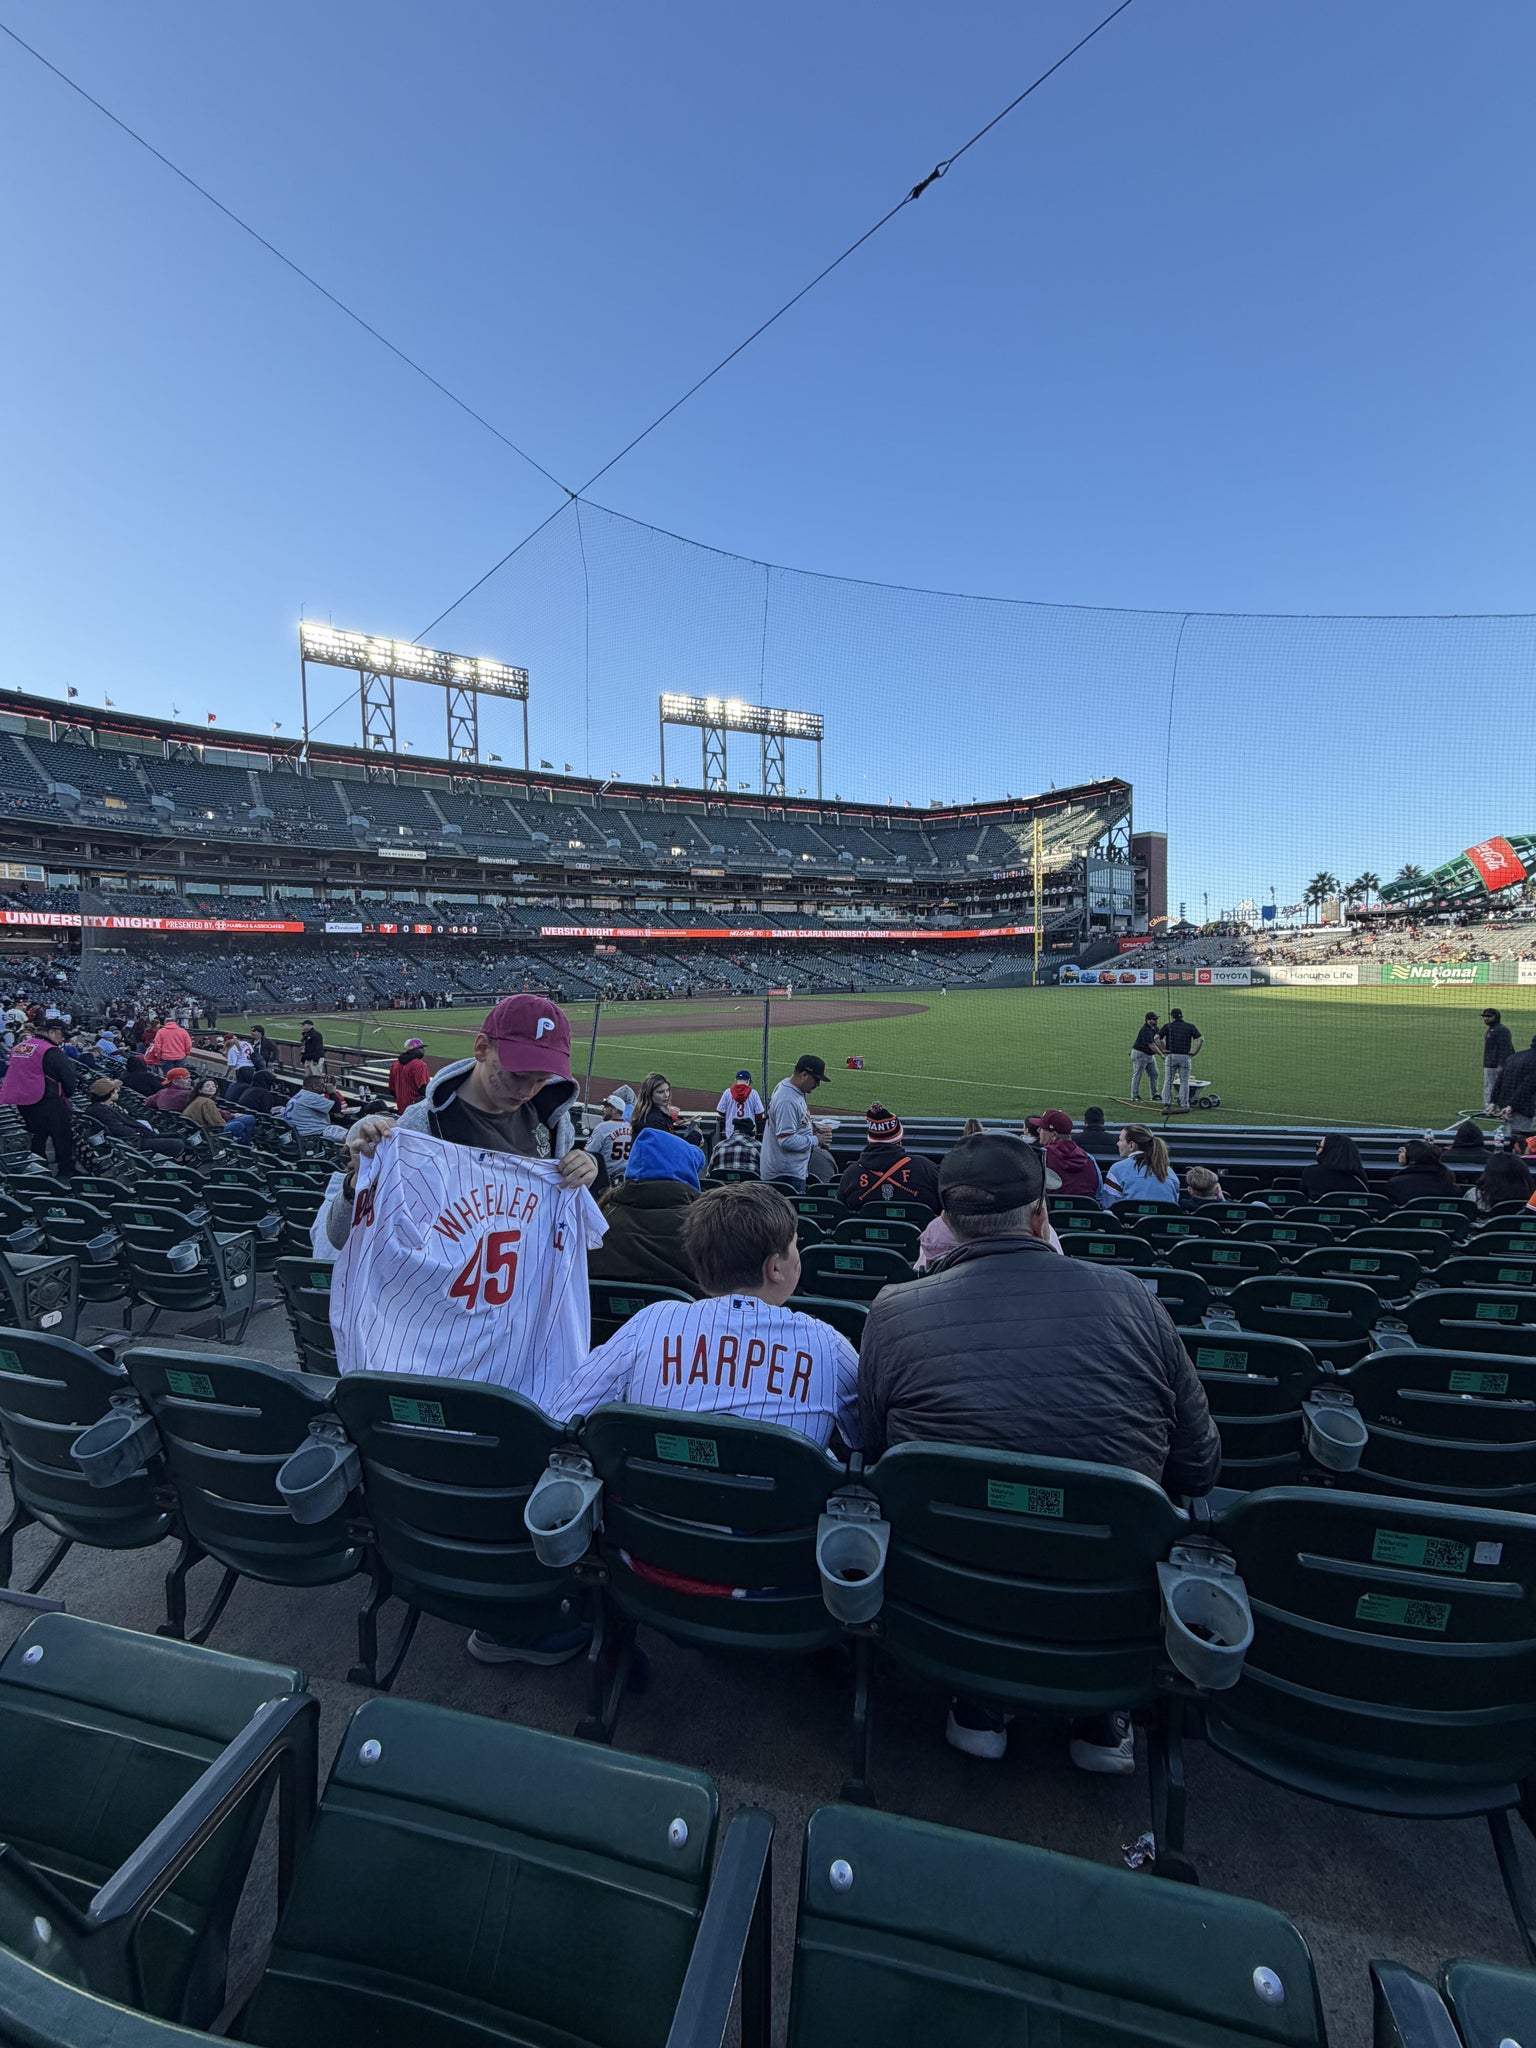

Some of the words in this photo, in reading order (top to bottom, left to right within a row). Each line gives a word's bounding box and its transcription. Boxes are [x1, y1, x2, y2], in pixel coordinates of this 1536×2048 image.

[5, 911, 110, 927] UNIVERSITY
[112, 917, 163, 930] NIGHT
[165, 920, 203, 929] PRESENTED
[586, 928, 615, 937] NIGHT
[1291, 970, 1330, 980] Hanwha
[1334, 970, 1353, 979] Life
[1410, 966, 1478, 978] National
[535, 1017, 555, 1040] P
[736, 1101, 745, 1118] 3
[610, 1127, 632, 1141] LINCEC
[859, 1174, 868, 1187] S
[902, 1170, 910, 1183] F
[433, 1184, 539, 1243] WHEELER
[449, 1229, 521, 1311] 45
[47, 1314, 54, 1325] 7
[662, 1333, 813, 1403] HARPER
